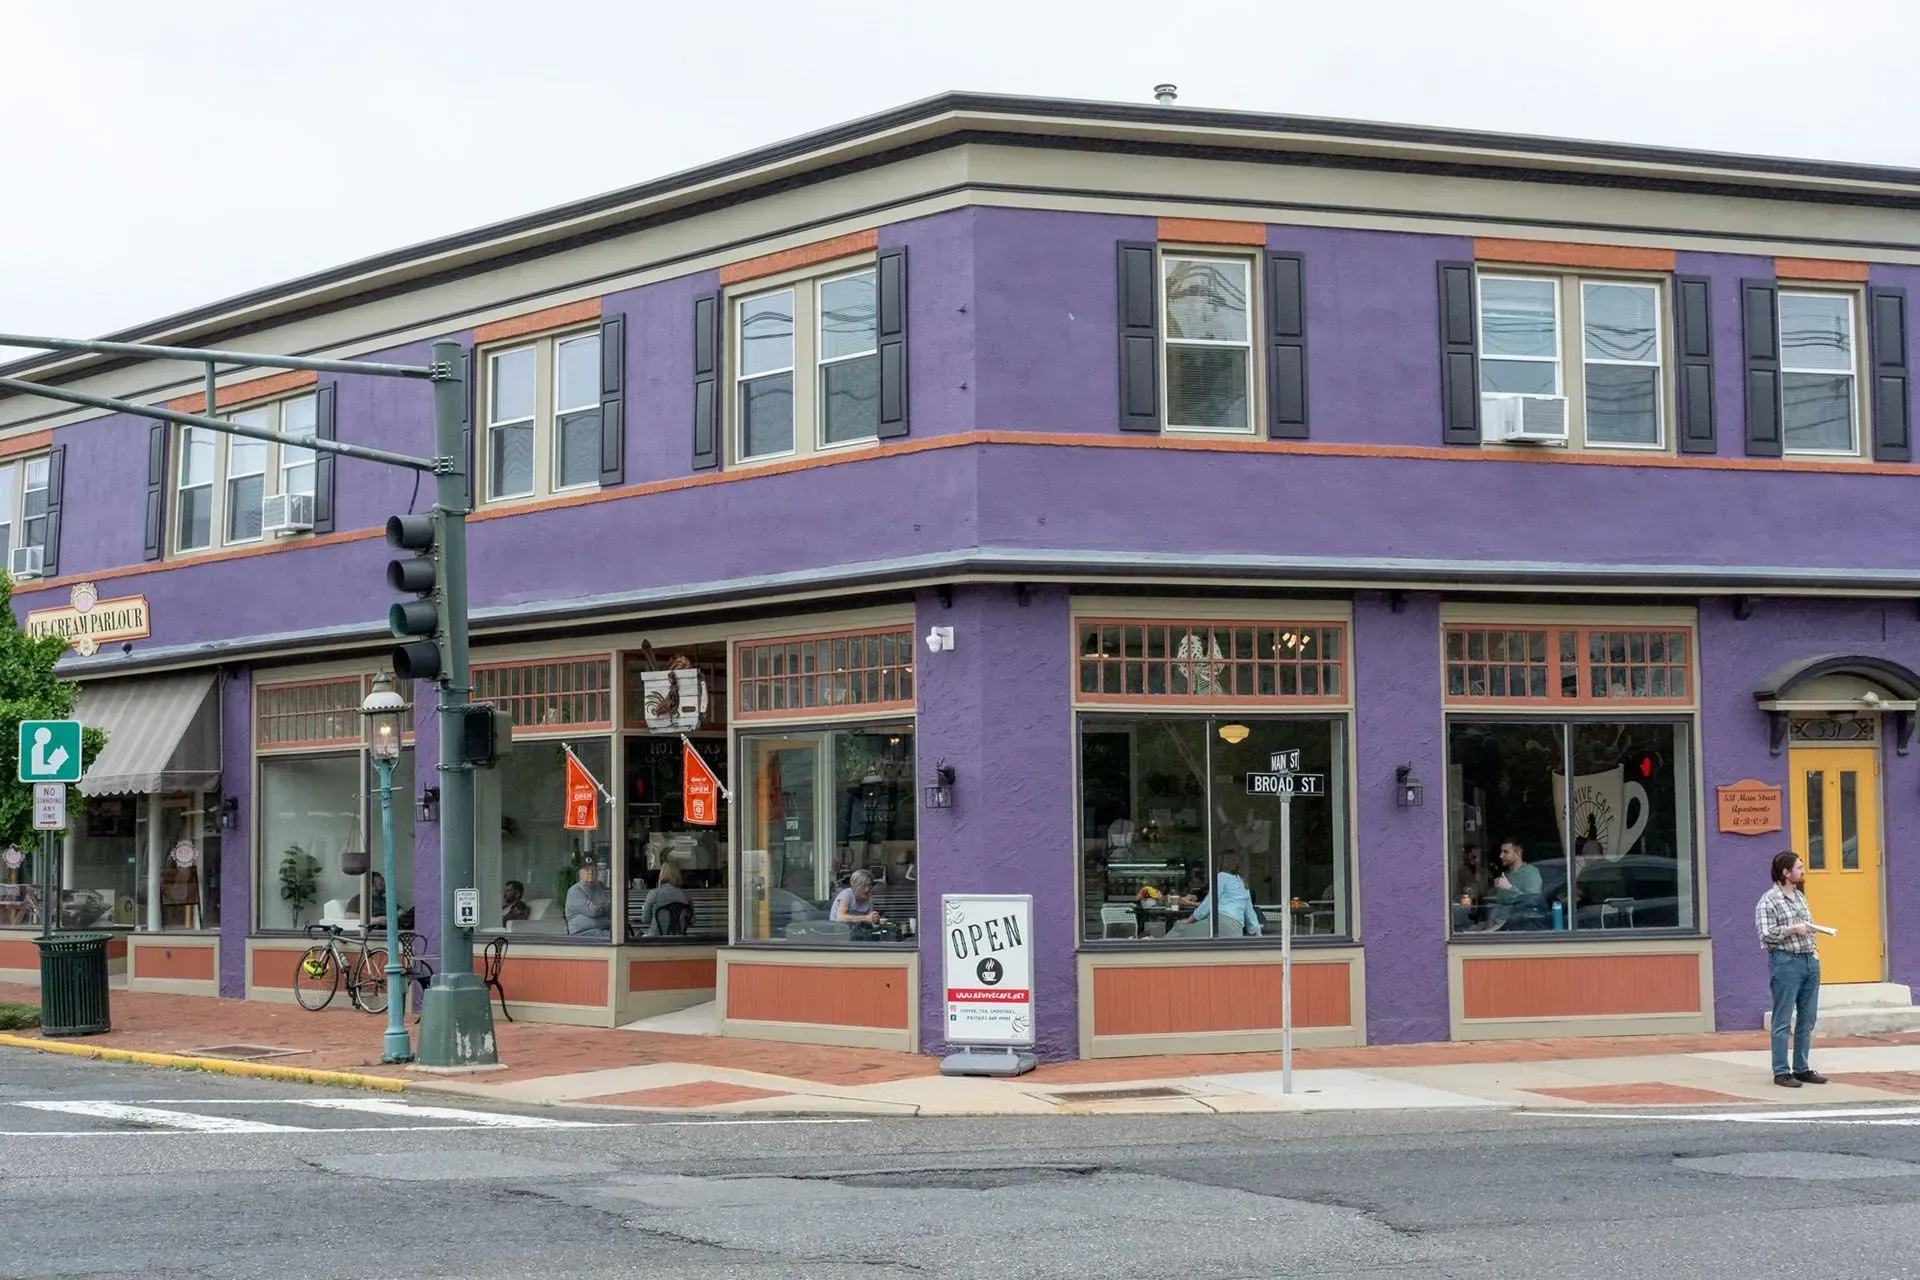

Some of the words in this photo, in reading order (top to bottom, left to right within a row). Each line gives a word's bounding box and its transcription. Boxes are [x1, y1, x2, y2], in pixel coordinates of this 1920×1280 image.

[91, 607, 143, 634] PARLOUR
[1271, 754, 1287, 771] MAIN
[1290, 752, 1299, 768] ST
[43, 787, 56, 797] NO
[1254, 776, 1294, 792] BROAD
[1301, 777, 1316, 793] ST
[1757, 793, 1777, 801] Street
[1732, 805, 1770, 814] Apartments
[951, 915, 1022, 959] OPEN
